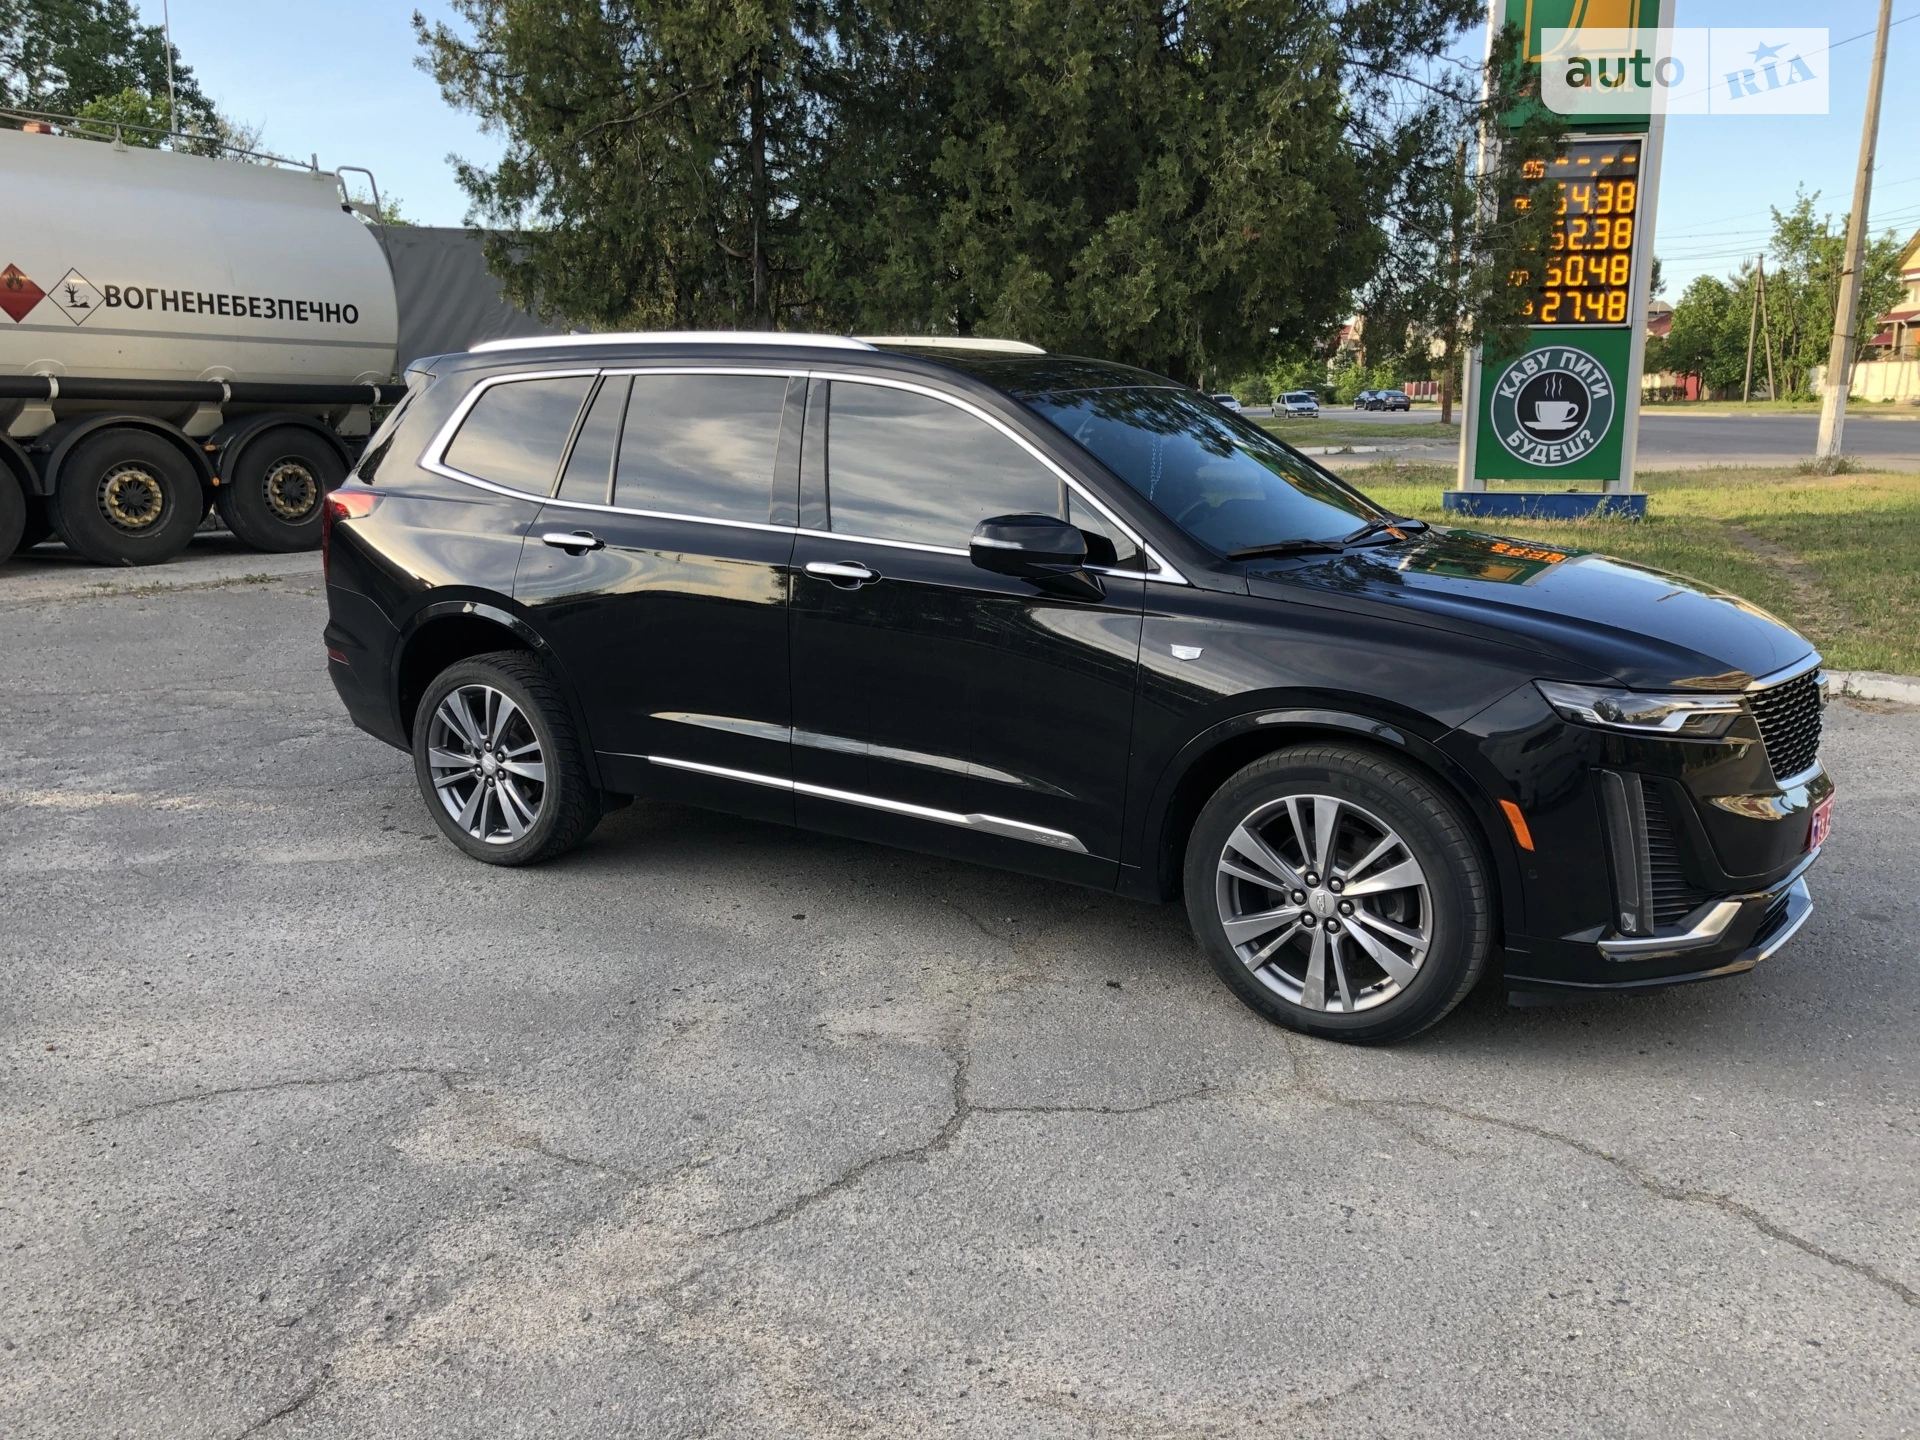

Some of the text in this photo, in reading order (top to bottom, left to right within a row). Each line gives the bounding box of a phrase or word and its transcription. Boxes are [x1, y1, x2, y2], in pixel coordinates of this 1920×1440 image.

[1545, 254, 1629, 287] 50.48
[104, 284, 359, 325] ВОГНЕНЕБЕЗПЕЧНО
[1541, 290, 1626, 322] 27.48
[1499, 352, 1608, 399] КАВУ ПИТИ
[1506, 429, 1594, 464] БУДЕШ?
